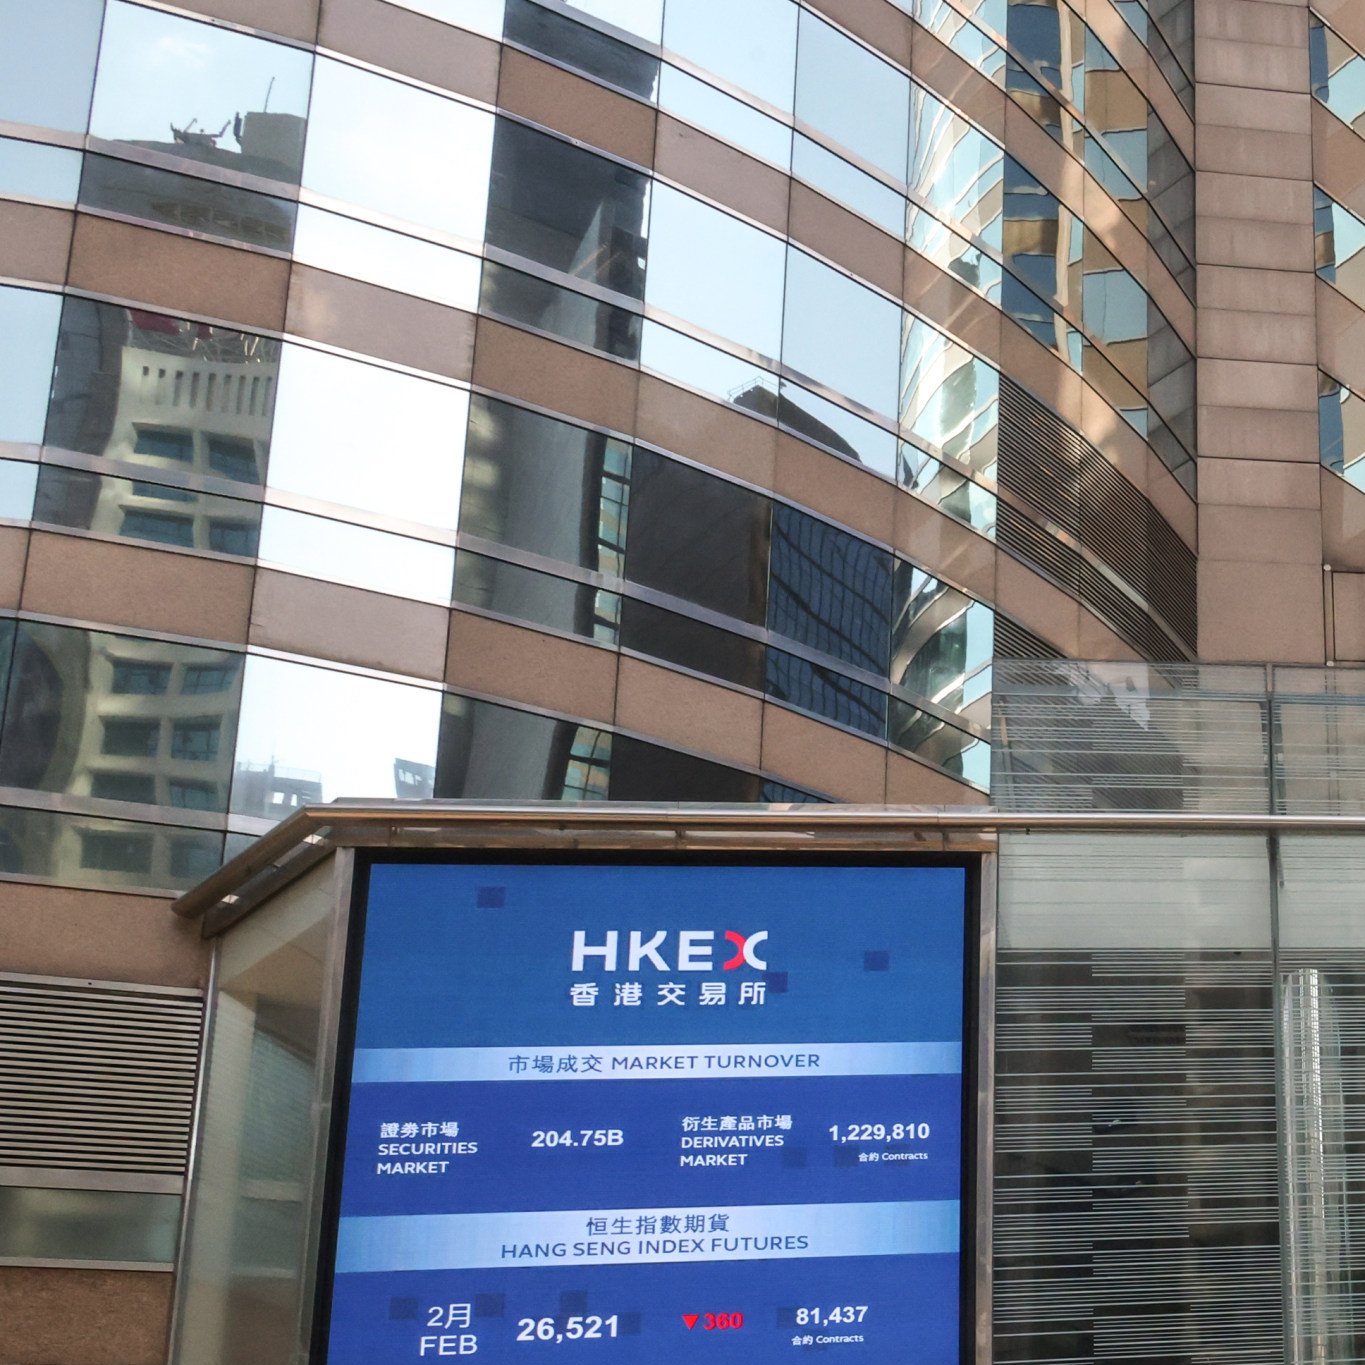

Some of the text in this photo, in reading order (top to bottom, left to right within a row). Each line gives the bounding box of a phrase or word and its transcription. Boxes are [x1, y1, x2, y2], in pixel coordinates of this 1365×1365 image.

[572, 930, 768, 971] HKEX
[570, 982, 766, 1006] 香港交易所
[508, 1054, 820, 1074] 市場成交 MARKET TURNOVER
[682, 1114, 793, 1132] 衍生產品市場
[829, 1123, 930, 1143] 1,229,810
[531, 1129, 624, 1147] 204.75B
[681, 1135, 784, 1148] DERIVATIVES
[378, 1142, 478, 1155] SECURITIES
[858, 1152, 928, 1162] 合約 Contracts
[377, 1161, 450, 1174] MARKET
[680, 1154, 748, 1167] MARKET
[586, 1213, 730, 1237] 恒生指數期貨
[501, 1235, 809, 1259] HANG SENG INDEX FUTURES
[427, 1303, 471, 1329] 2月
[703, 1312, 744, 1330] 360
[796, 1306, 868, 1327] 81,437
[516, 1315, 618, 1344] 26,521
[420, 1334, 478, 1356] FEB
[791, 1335, 864, 1346] 合約 Contracts
